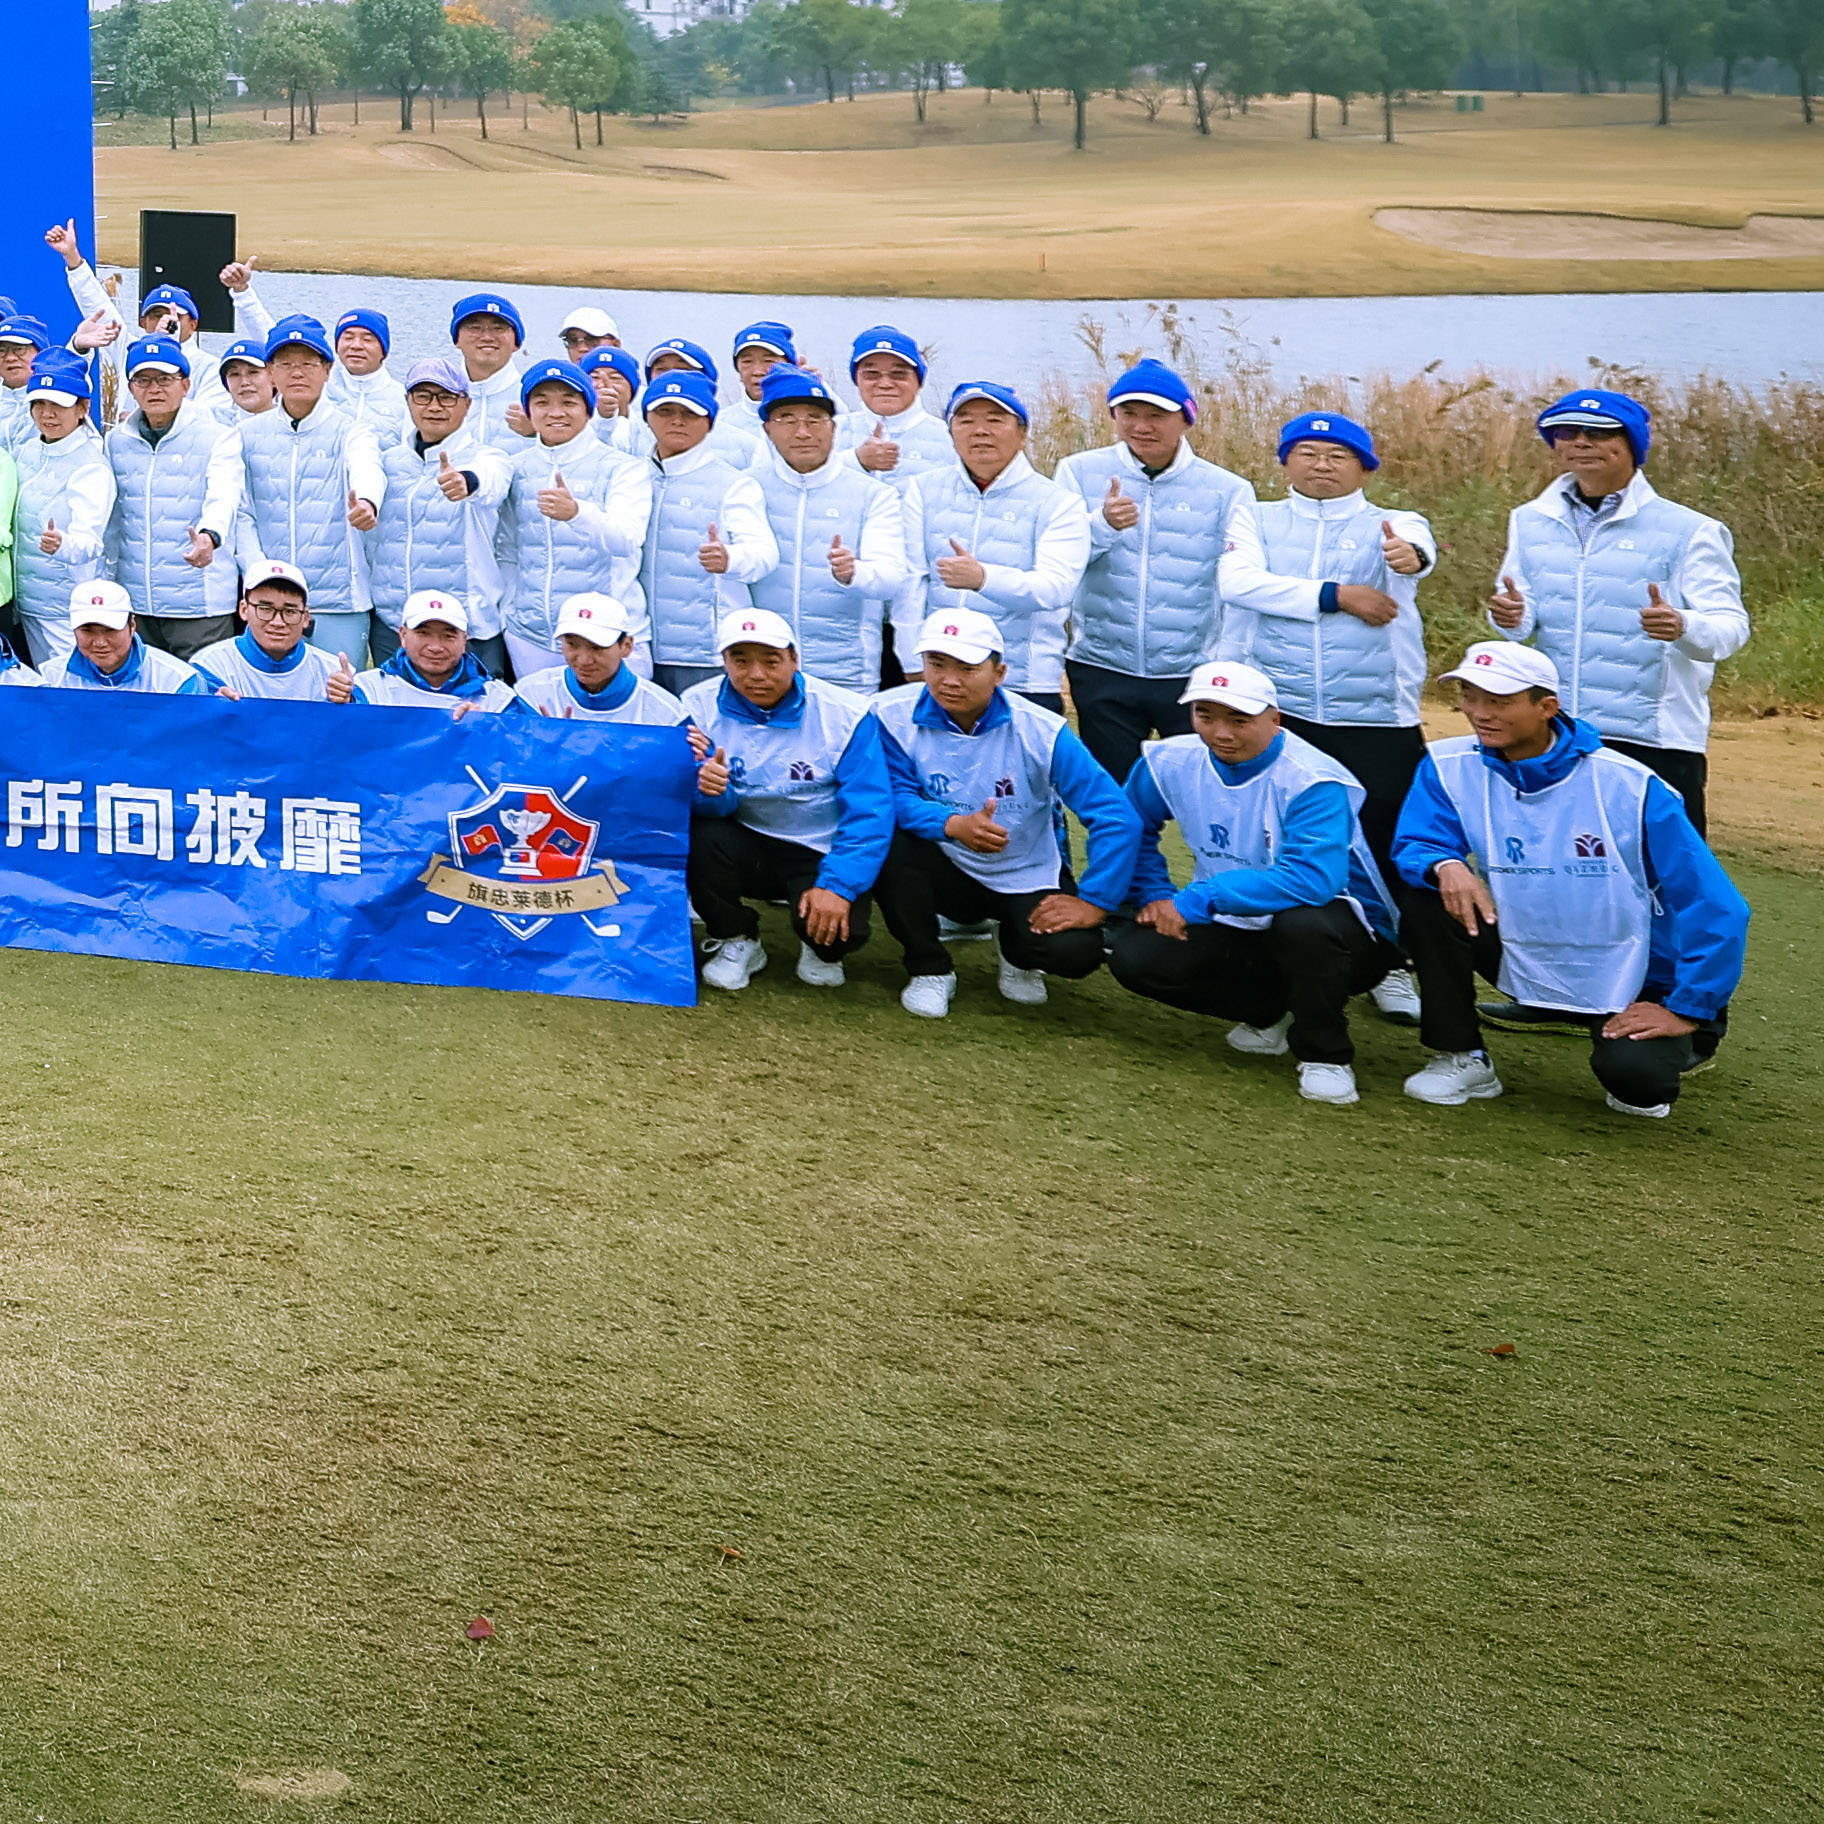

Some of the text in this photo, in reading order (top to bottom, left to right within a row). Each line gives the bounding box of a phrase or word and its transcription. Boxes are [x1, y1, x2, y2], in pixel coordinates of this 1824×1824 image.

[467, 882, 575, 909] 旗忠莱德杯
